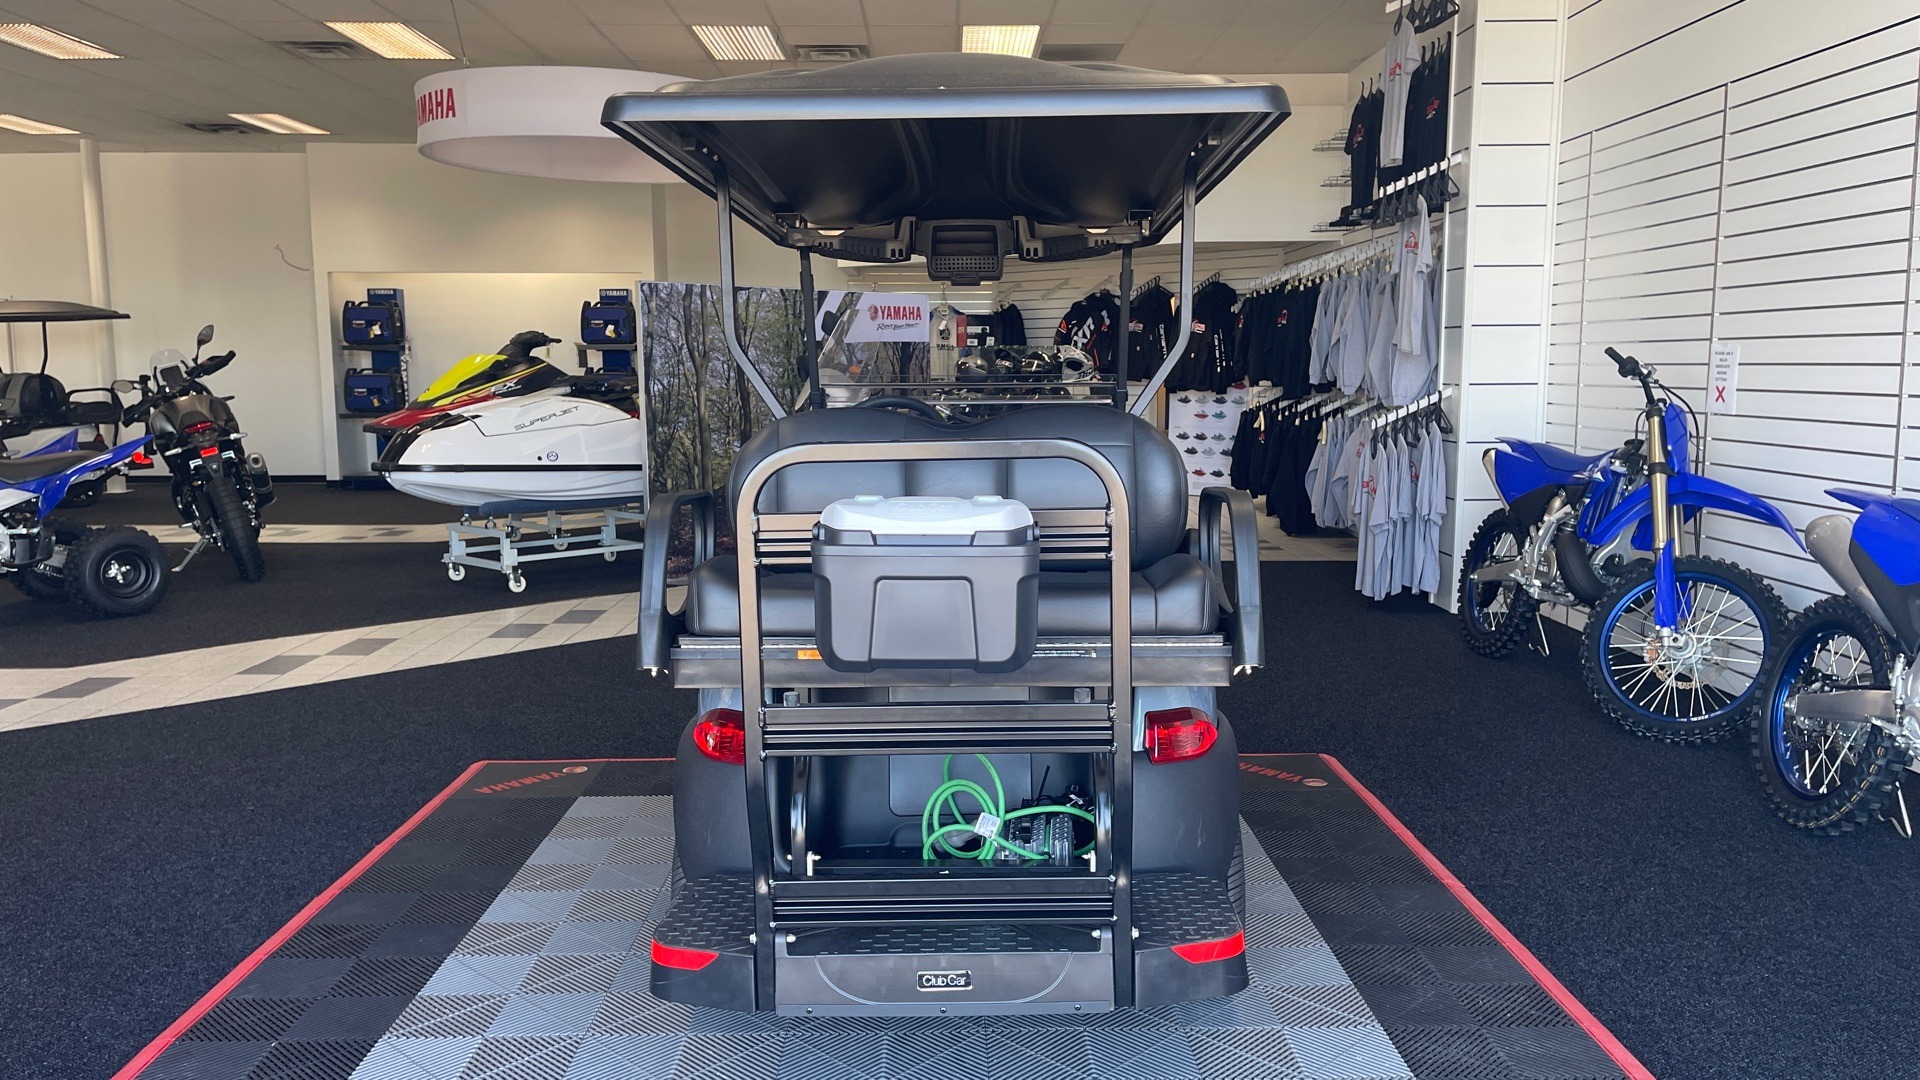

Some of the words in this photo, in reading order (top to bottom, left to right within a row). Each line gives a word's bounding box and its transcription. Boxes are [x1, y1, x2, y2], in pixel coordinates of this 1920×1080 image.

[416, 88, 456, 126] AMAHA
[879, 305, 922, 321] YAMAHA
[513, 405, 580, 431] SUPERJET
[896, 502, 927, 511] Club
[927, 502, 951, 511] Car
[474, 771, 567, 794] YAMAHA
[1239, 762, 1303, 783] YAMAH
[922, 974, 947, 986] Club
[947, 974, 967, 986] Car
